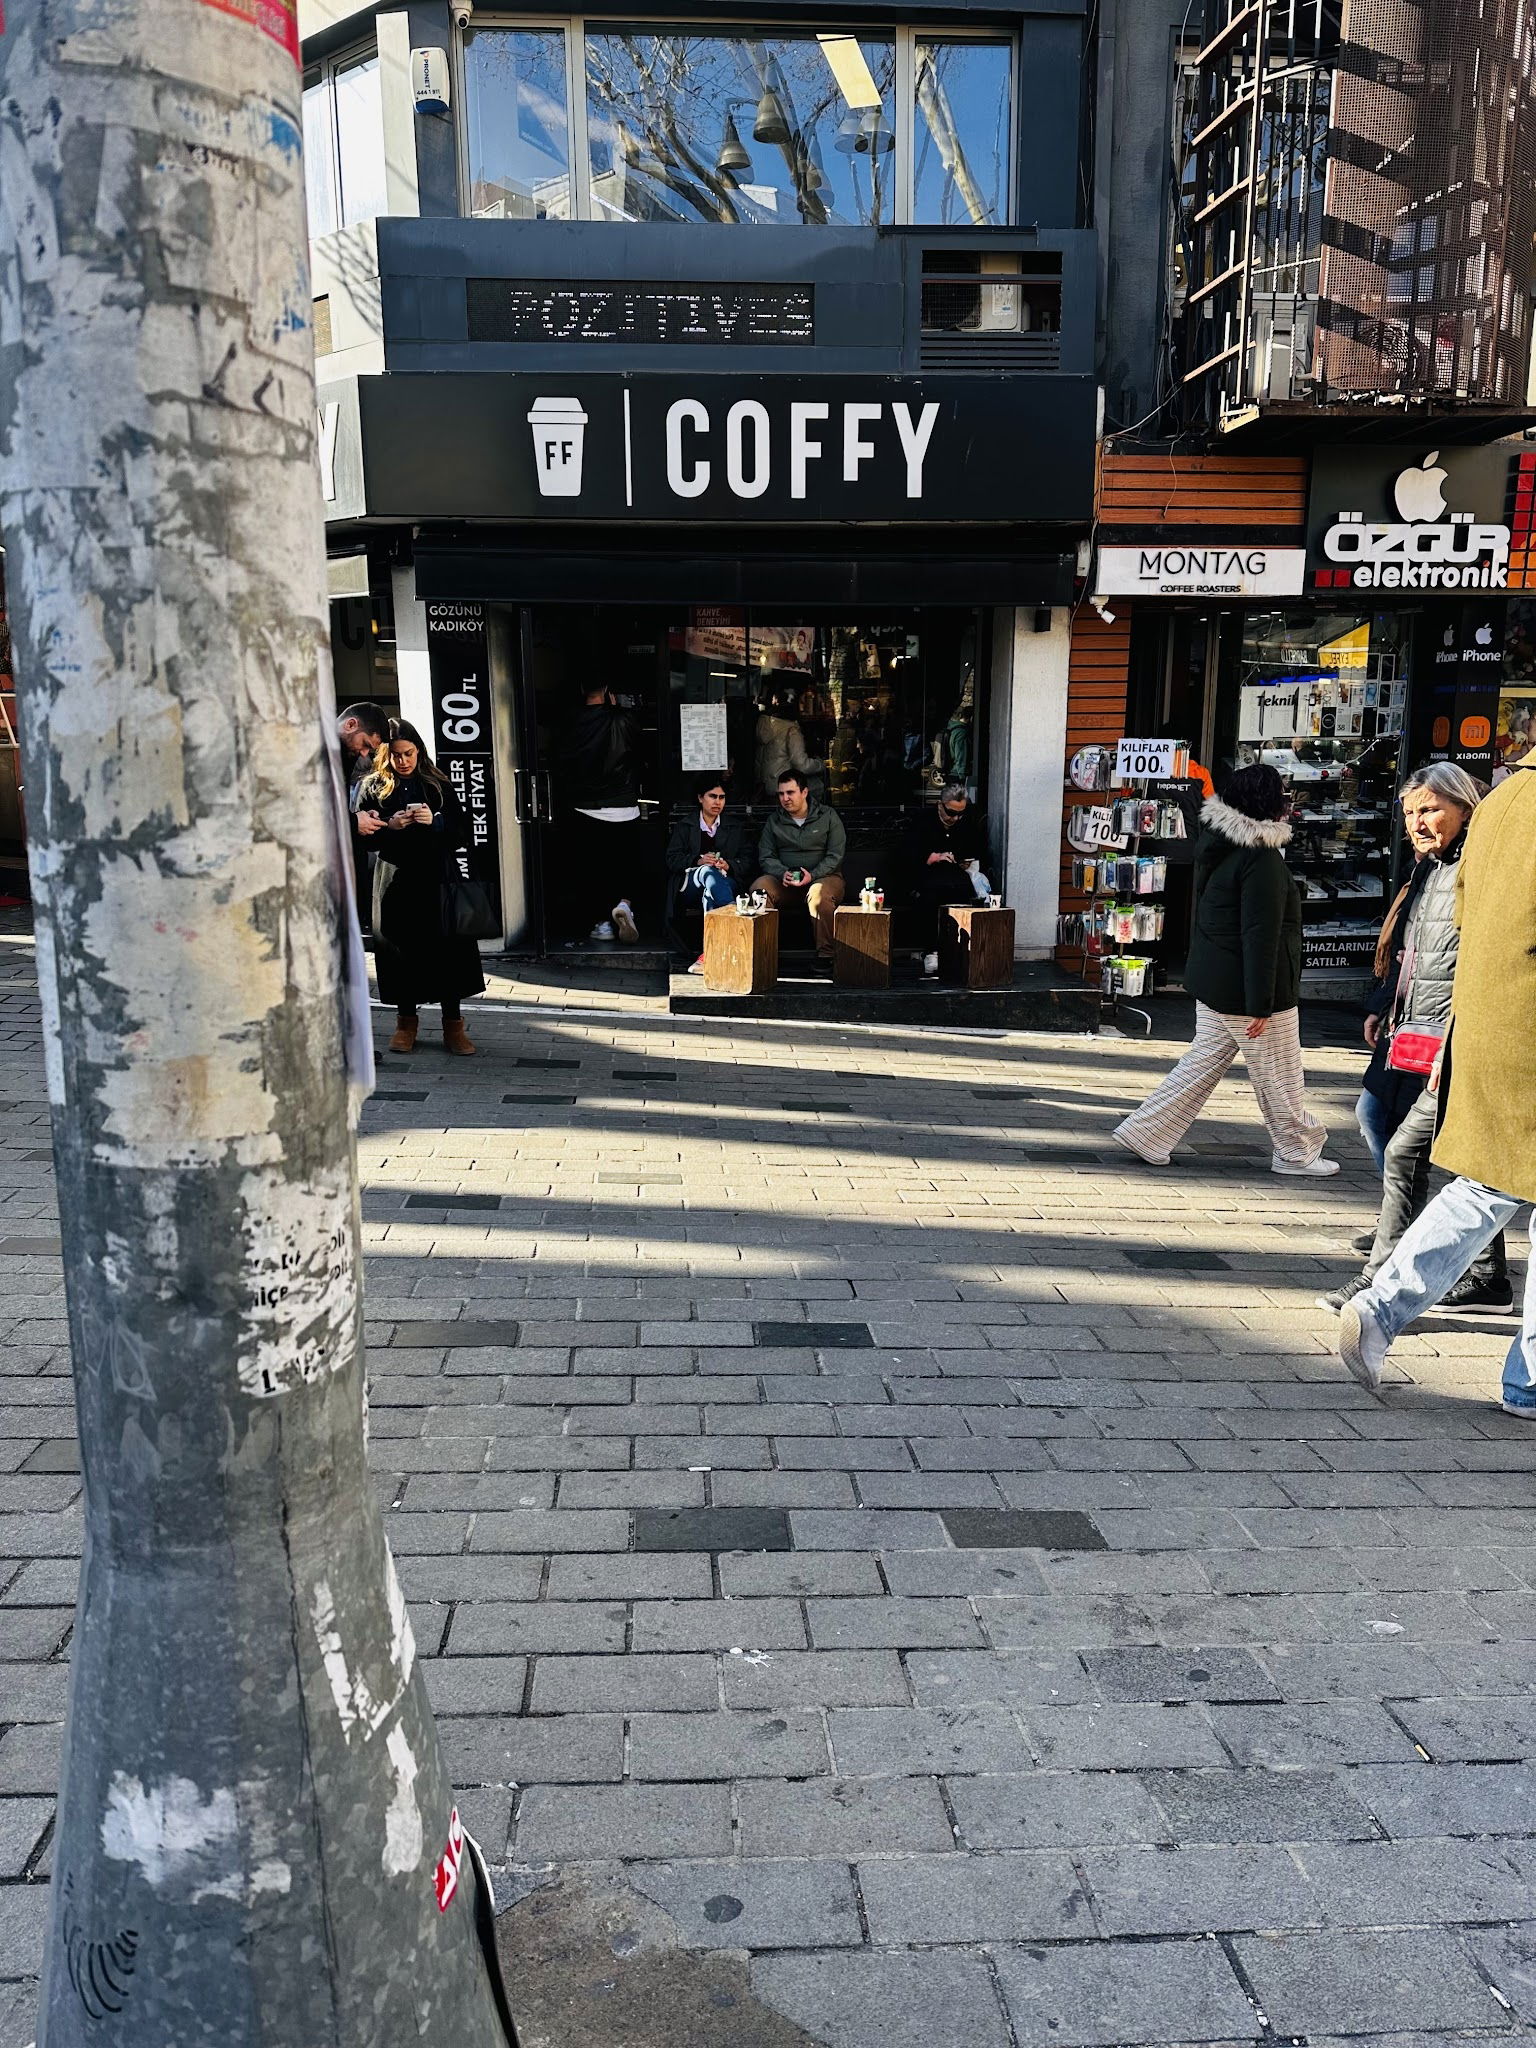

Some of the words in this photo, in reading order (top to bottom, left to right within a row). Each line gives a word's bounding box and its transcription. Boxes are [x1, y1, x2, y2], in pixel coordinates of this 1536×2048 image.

[667, 400, 940, 498] COFFY
[1324, 512, 1510, 562] ÖZGÜR
[1139, 551, 1266, 580] MONTAG
[1352, 561, 1508, 589] elektronik
[1160, 584, 1194, 593] COFFEE
[1196, 584, 1242, 593] ROASTERS
[429, 618, 485, 632] KADIKÖY
[1462, 649, 1501, 662] iPhone
[1121, 743, 1170, 753] KILIFLAR
[468, 760, 486, 808] FİYAT
[472, 812, 488, 846] TEK
[1303, 941, 1376, 952] İHAZLARINIZ
[1306, 957, 1349, 966] SATILIR.
